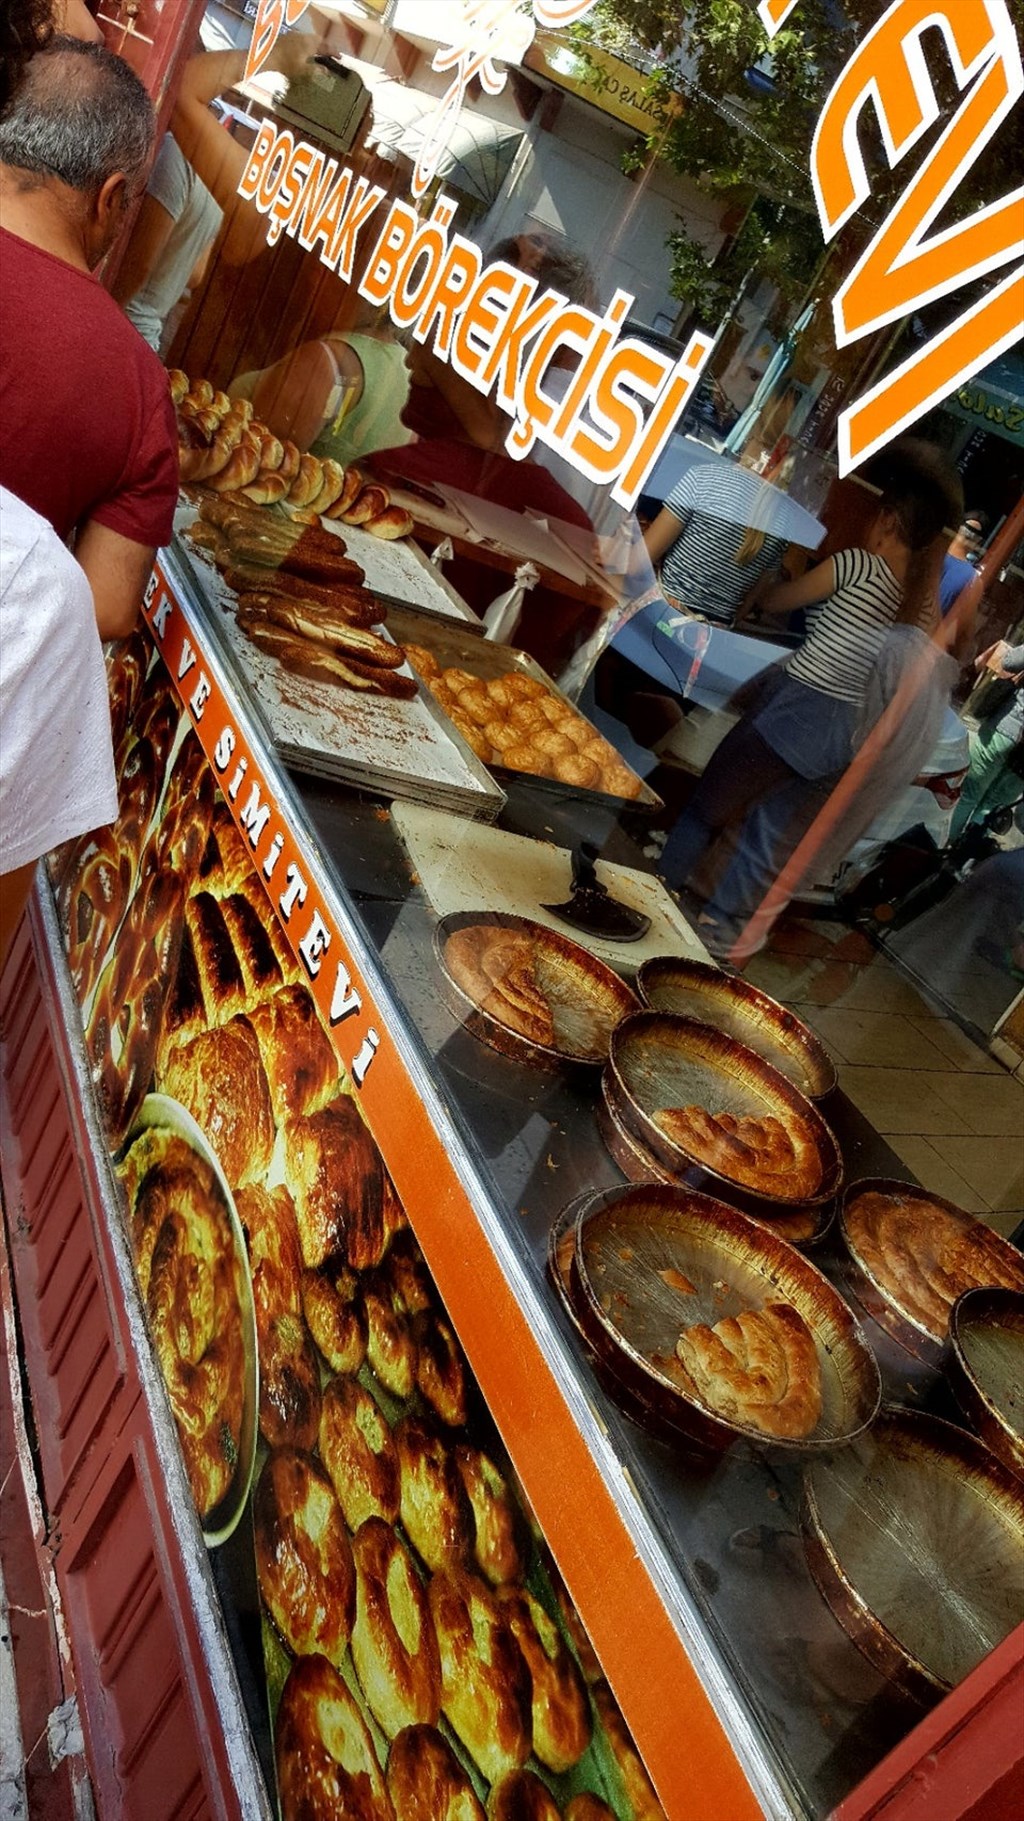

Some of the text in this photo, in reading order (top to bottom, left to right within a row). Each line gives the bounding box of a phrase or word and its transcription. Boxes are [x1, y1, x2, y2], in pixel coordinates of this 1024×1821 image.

[237, 118, 716, 511] BOŞNAK BÖREKÇİSİ
[178, 638, 212, 720] VE
